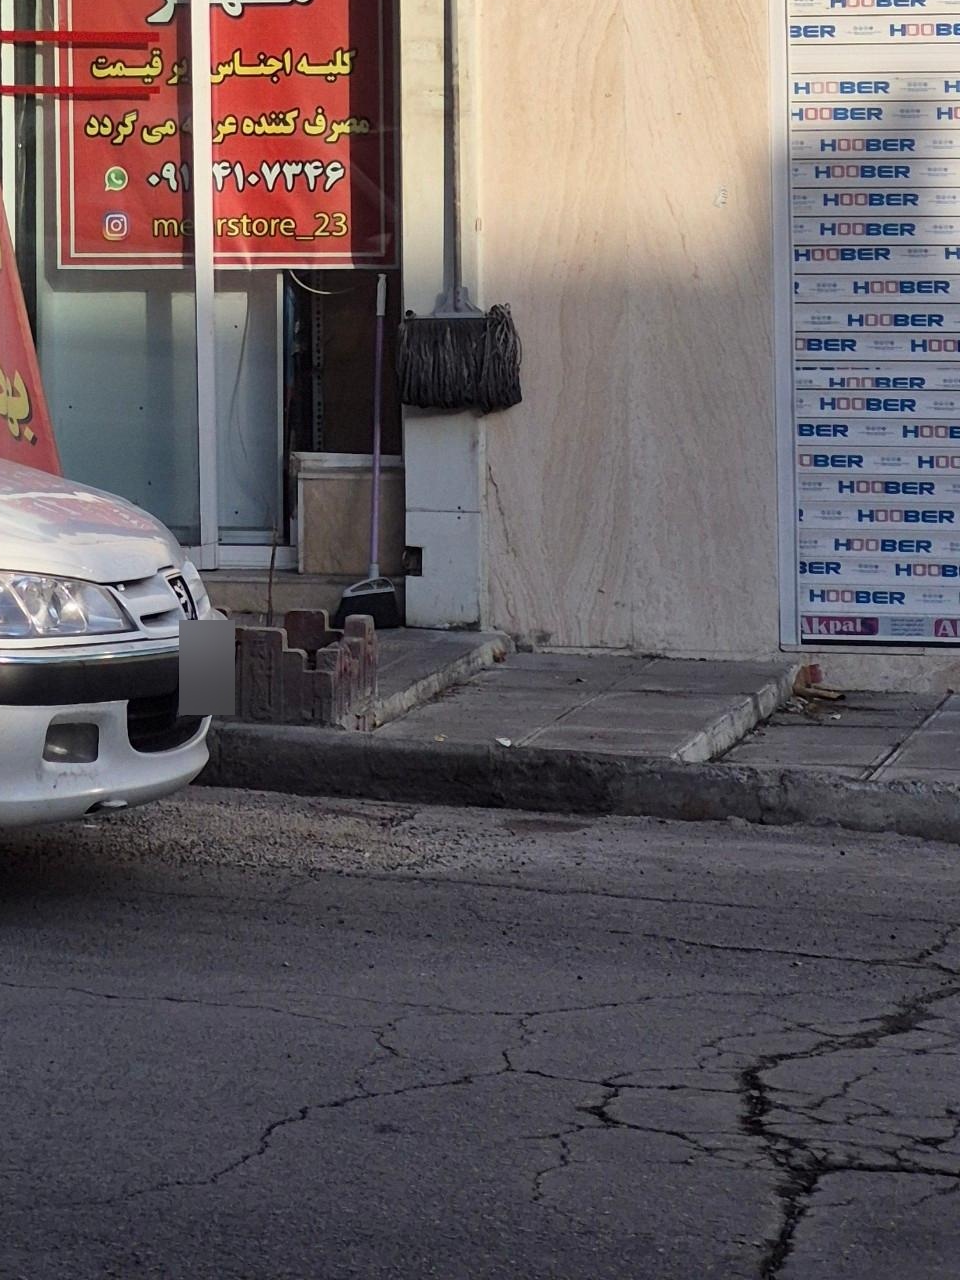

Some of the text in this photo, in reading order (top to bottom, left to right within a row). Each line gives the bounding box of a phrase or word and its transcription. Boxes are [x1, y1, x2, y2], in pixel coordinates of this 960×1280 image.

[91, 49, 163, 84] قیمت
[210, 49, 292, 85] اجناس
[296, 47, 357, 81] کلیه
[794, 81, 890, 96] HOOBER
[86, 109, 139, 144] گردد
[142, 117, 176, 144] می
[242, 110, 299, 136] کننده
[303, 107, 371, 143] مصرف
[820, 138, 916, 153] HOOBER
[147, 161, 345, 193] ۰۹۱۴۱۰۷۳۴۶
[814, 165, 911, 180] HOOBER
[823, 193, 919, 208] HOOBER
[152, 213, 349, 240] merstore_23
[820, 222, 916, 237] HOOBER
[794, 247, 890, 263] HOOBER
[853, 280, 950, 296] HOOBER
[847, 314, 944, 329] HOOBER
[819, 397, 916, 412] HOOBER
[838, 480, 935, 495] HOOBER
[857, 509, 954, 525] HOOBER
[834, 538, 932, 553] HOOBER
[809, 590, 906, 605] HOOBER
